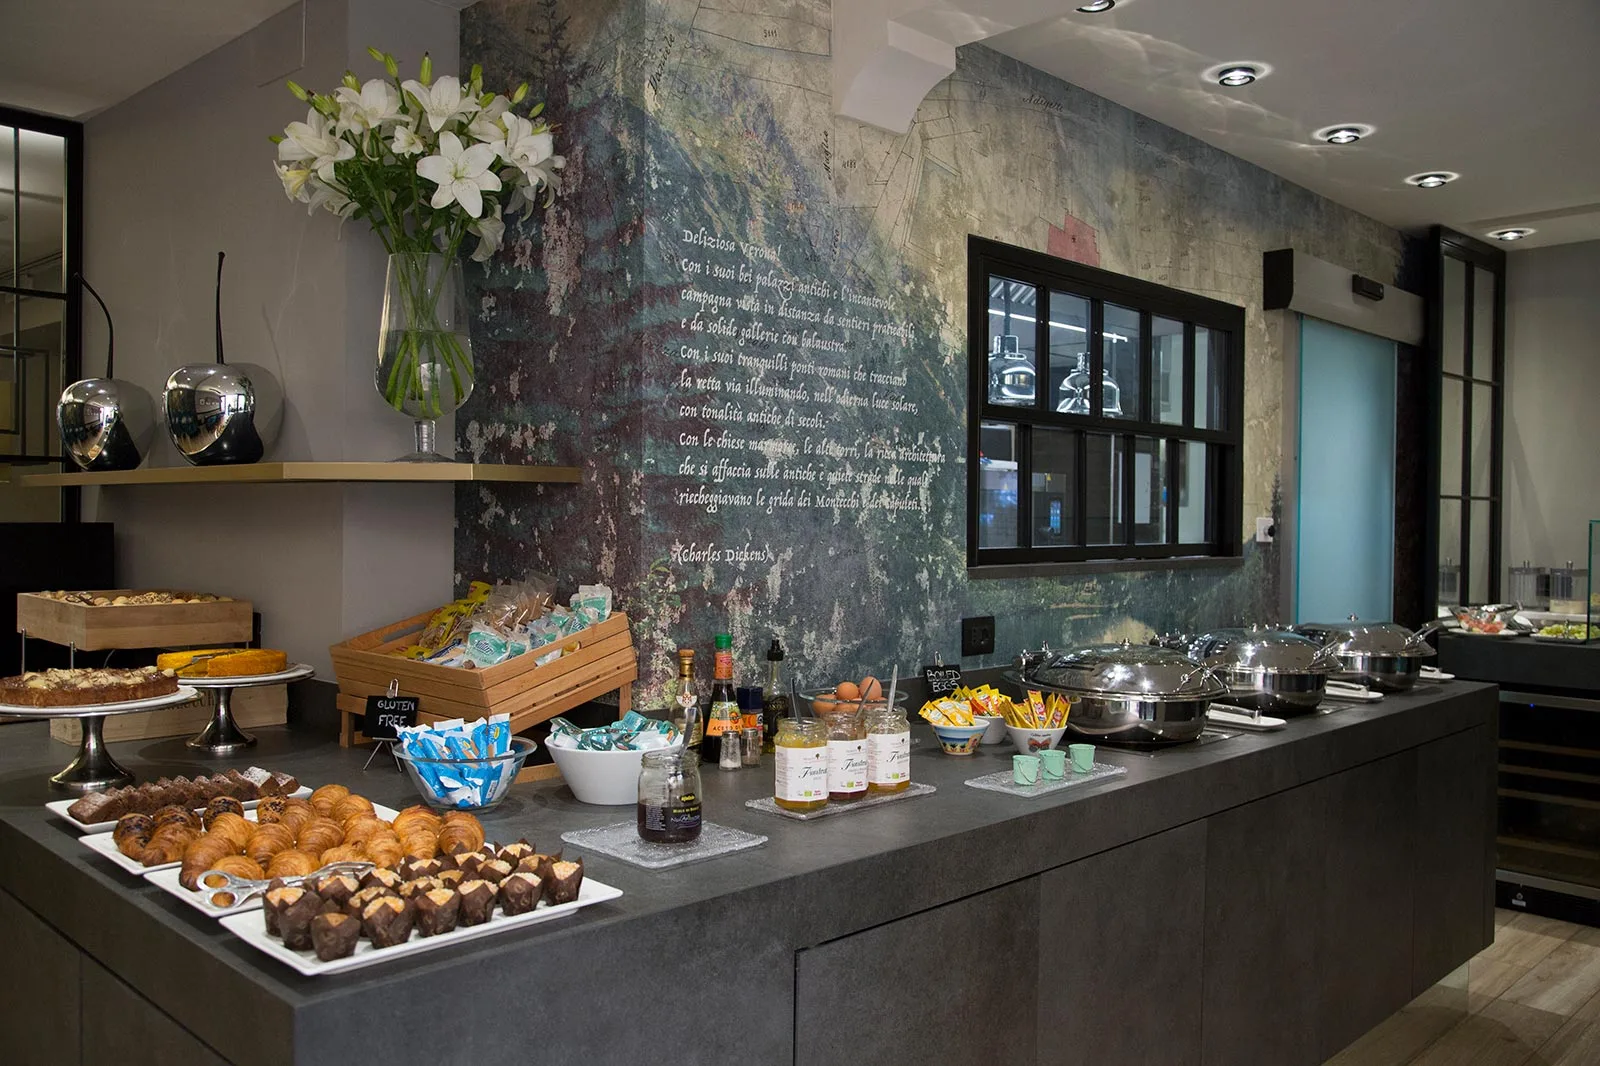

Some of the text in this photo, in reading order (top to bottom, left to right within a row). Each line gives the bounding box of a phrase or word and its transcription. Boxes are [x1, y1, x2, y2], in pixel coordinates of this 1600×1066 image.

[682, 227, 735, 252] Deliziosa
[740, 241, 781, 261] Verona!
[681, 258, 701, 273] Con
[713, 265, 735, 280] suoi
[740, 263, 753, 283] bei
[754, 269, 797, 301] palazzi
[798, 278, 831, 300] antichi
[841, 284, 896, 311] l'incantevole
[681, 288, 732, 314] campagna
[736, 297, 761, 313] vista
[764, 299, 775, 315] in
[778, 299, 820, 322] distanza
[823, 307, 835, 326] da
[837, 314, 870, 332] sentieri
[681, 318, 687, 329] e
[690, 312, 704, 332] da
[707, 316, 737, 337] solide
[739, 321, 780, 346] gallerie
[782, 332, 800, 346] con
[801, 329, 848, 353] balaustra.
[680, 345, 700, 361] Con
[712, 349, 734, 365] suoi
[738, 352, 789, 377] tranquilli
[790, 360, 816, 381] ponti
[818, 365, 852, 380] romani
[853, 364, 867, 382] che
[681, 367, 919, 414] la retta via illuminando, nell'odierna luce solare,
[679, 401, 827, 429] con tonalità antiche di secoli.
[679, 432, 699, 446] Con
[703, 428, 714, 448] le
[716, 429, 745, 449] chiese
[803, 435, 814, 455] le
[838, 444, 861, 460] torri,
[864, 440, 875, 458] la
[679, 455, 696, 476] che
[699, 459, 709, 476] si
[711, 457, 752, 483] affaccia
[754, 459, 780, 479] sulle
[783, 462, 817, 481] antiche
[854, 466, 882, 484] strade
[678, 484, 752, 513] riecheggiavano
[756, 487, 766, 506] le
[766, 488, 795, 514] grida
[797, 488, 812, 507] dei
[815, 490, 860, 509] Montecchi
[869, 491, 882, 509] dei
[676, 542, 770, 566] (Charles Dickens)
[932, 679, 960, 693] EGGS
[377, 700, 415, 711] GLUTEN
[378, 714, 407, 727] FREE
